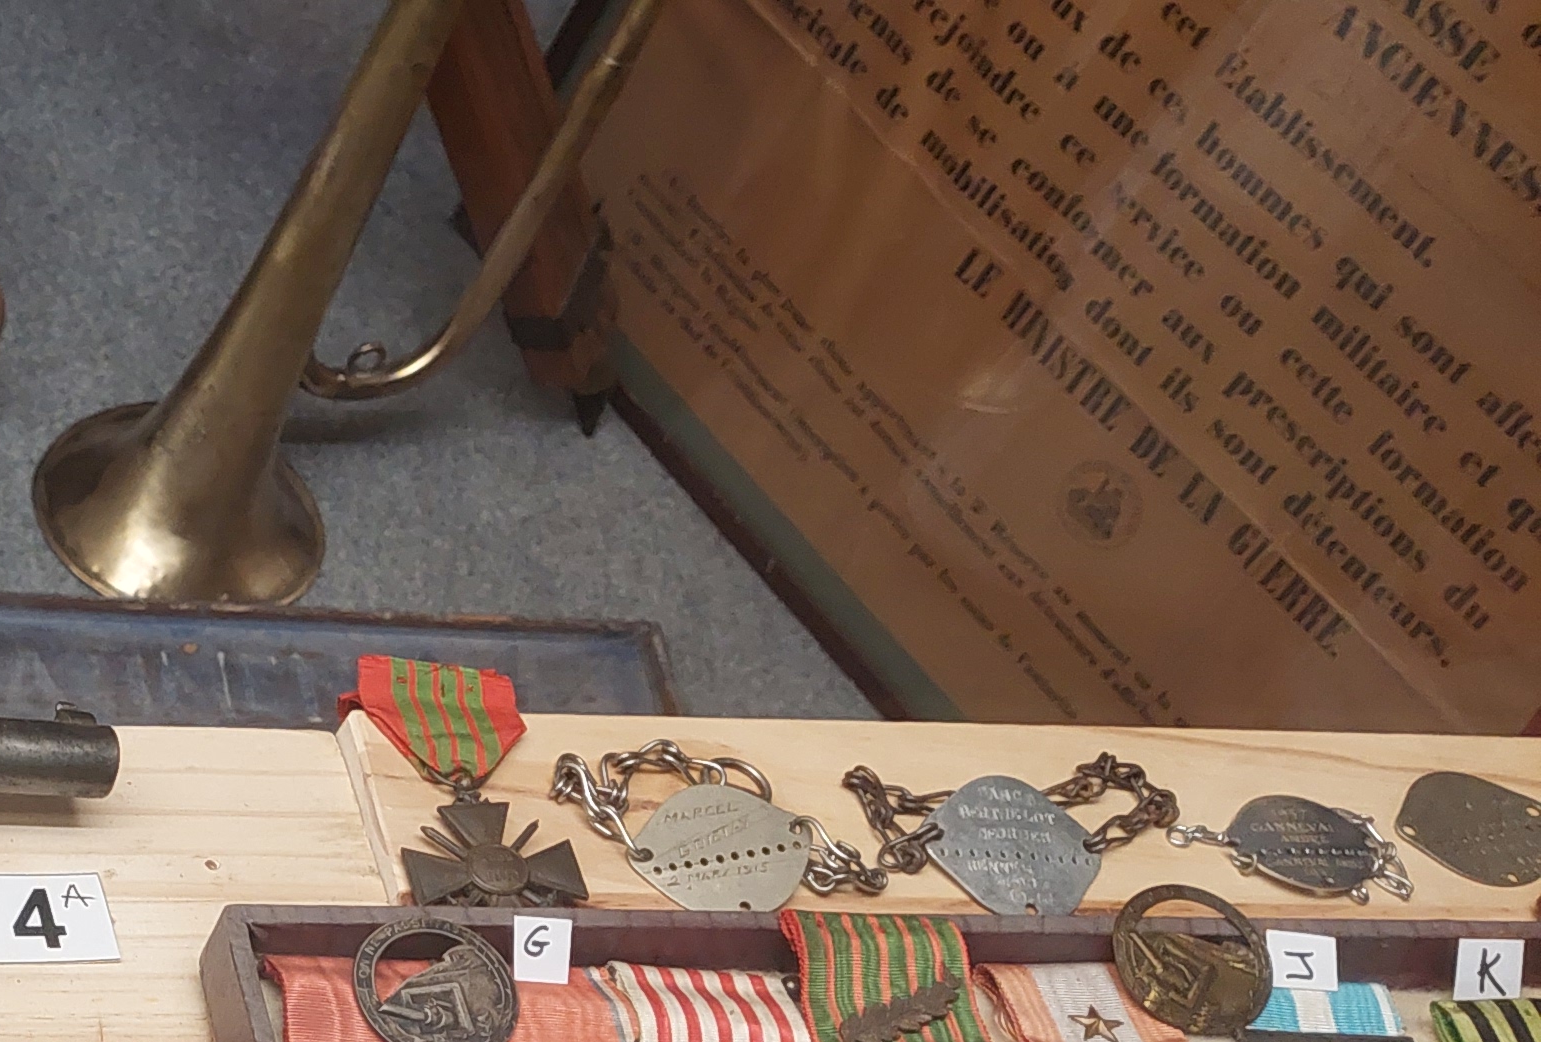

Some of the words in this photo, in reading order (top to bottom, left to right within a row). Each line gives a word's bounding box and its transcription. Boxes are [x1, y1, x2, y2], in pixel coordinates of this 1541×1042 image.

[874, 84, 909, 120] de
[1085, 297, 1154, 367] dont
[1160, 367, 1201, 414] ils
[1208, 418, 1278, 485] sont
[925, 68, 961, 102] de
[1161, 309, 1216, 366] aux
[1222, 371, 1426, 573] prescriptions
[1443, 583, 1490, 631] du
[1007, 22, 1046, 62] ou
[1093, 95, 1150, 147] une
[1150, 152, 1302, 299] formation
[1311, 305, 1447, 434] militaire
[1459, 451, 1501, 488] et
[1059, 134, 1097, 164] ce
[1220, 295, 1263, 337] ou
[1280, 348, 1353, 425] cette
[1368, 430, 1529, 593] formation
[1098, 30, 1142, 73] de
[1195, 120, 1327, 250] hommes
[1335, 256, 1394, 311] qui
[1395, 315, 1472, 385] sont
[954, 247, 1005, 299] LE
[1001, 289, 1132, 431] MINISTRE
[1129, 424, 1180, 478] DE
[1178, 471, 1224, 525] LA
[523, 925, 550, 957] G
[664, 801, 739, 824] MARCEL
[1477, 948, 1507, 997] K
